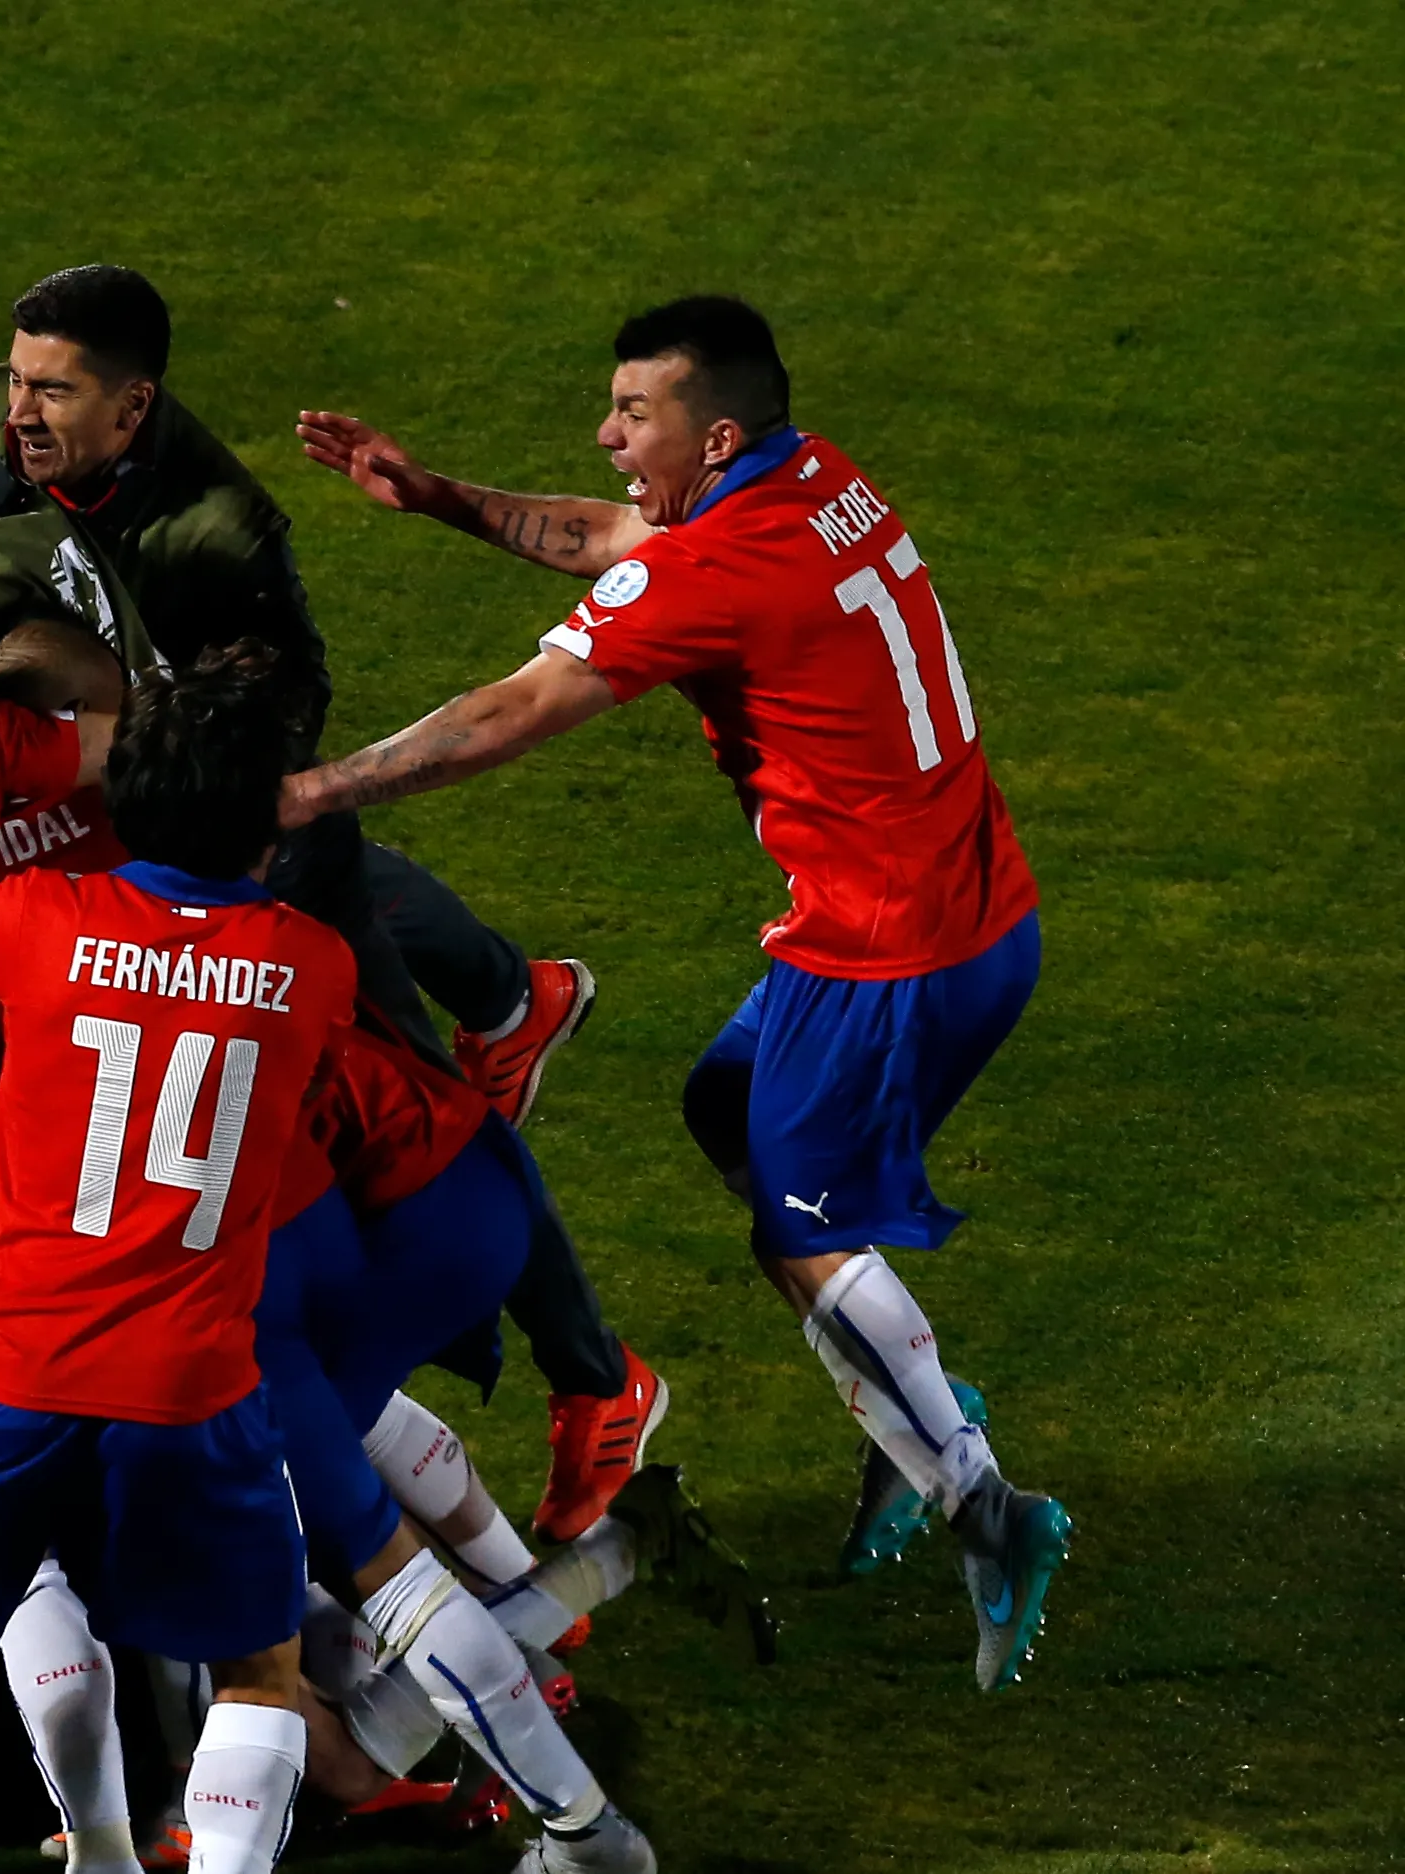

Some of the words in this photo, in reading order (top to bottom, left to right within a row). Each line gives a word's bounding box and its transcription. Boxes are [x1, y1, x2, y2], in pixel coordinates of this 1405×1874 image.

[808, 478, 890, 555] MEDEL
[833, 531, 976, 772] 17
[68, 937, 295, 1013] FERNÁNDEZ
[71, 1015, 260, 1251] 14
[36, 1657, 102, 1686] CHILE
[193, 1791, 260, 1811] CHILE
